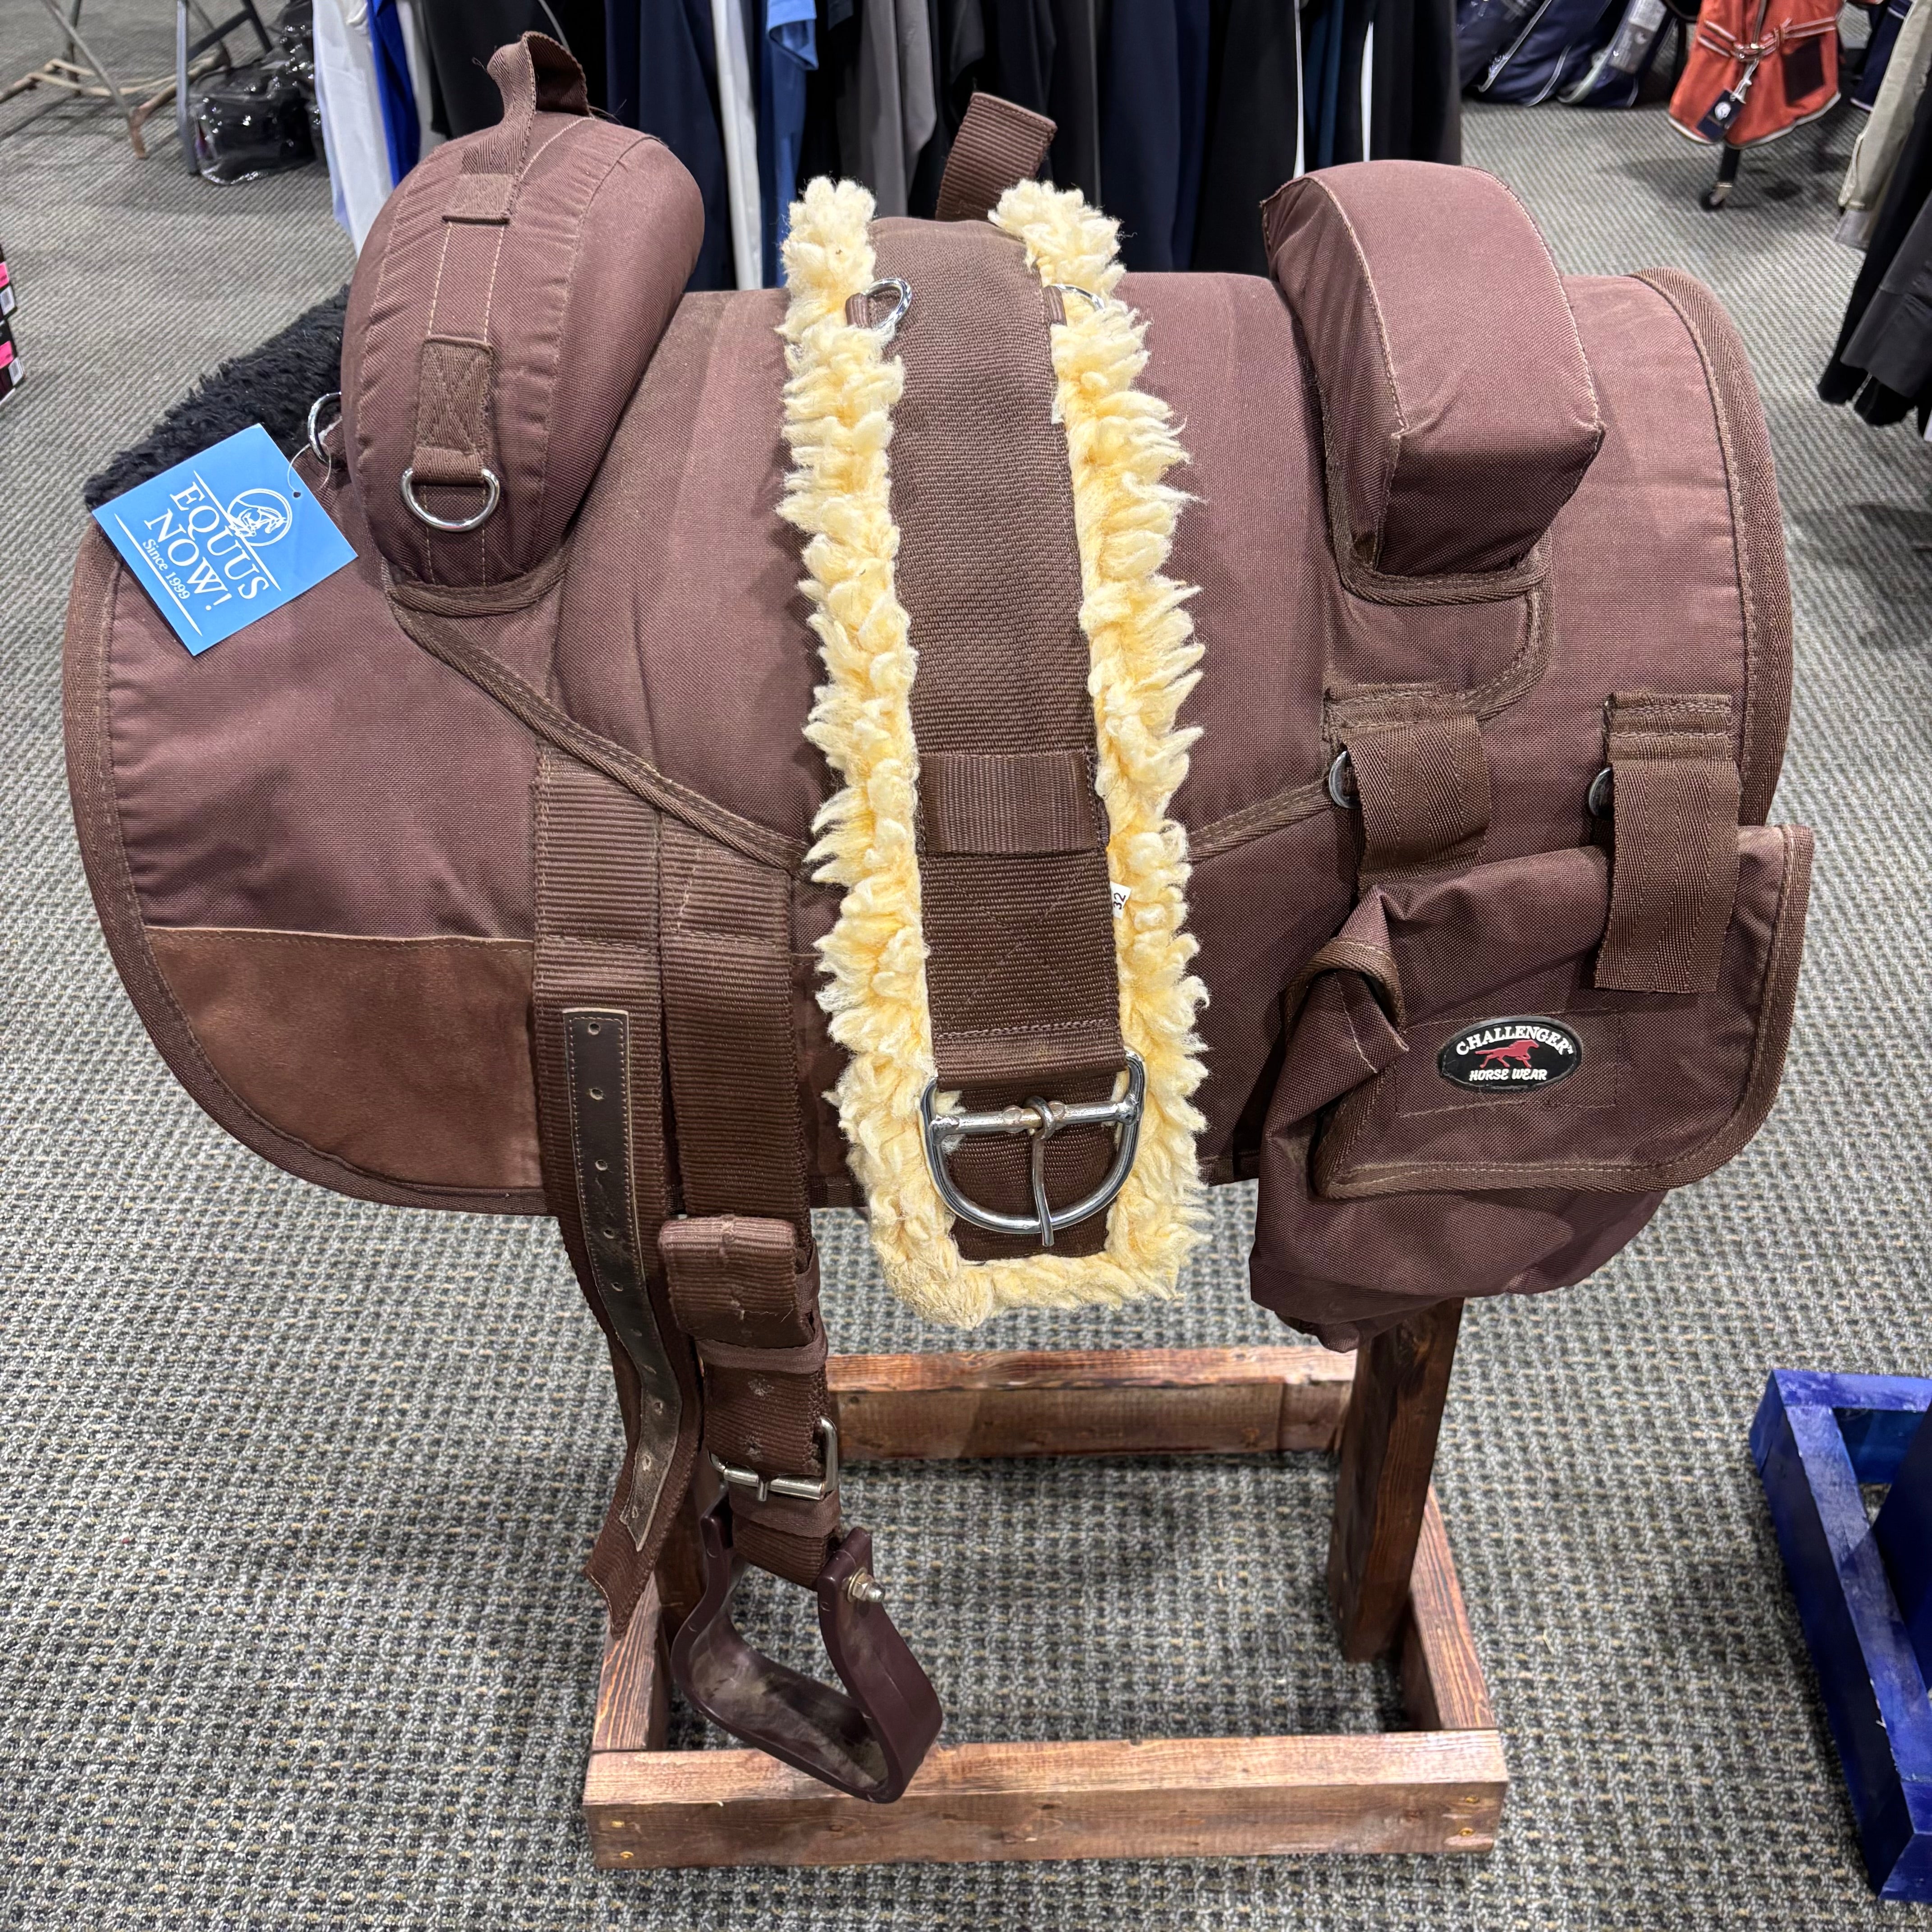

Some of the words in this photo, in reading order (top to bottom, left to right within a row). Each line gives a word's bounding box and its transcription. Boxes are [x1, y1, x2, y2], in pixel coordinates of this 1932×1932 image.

[143, 539, 168, 571] Since
[166, 572, 190, 599] 1999
[144, 508, 232, 611] NOW!
[170, 482, 269, 599] EQUUS
[1113, 892, 1126, 910] 32
[1469, 1069, 1509, 1081] HORSE
[1512, 1068, 1547, 1081] WEAR
